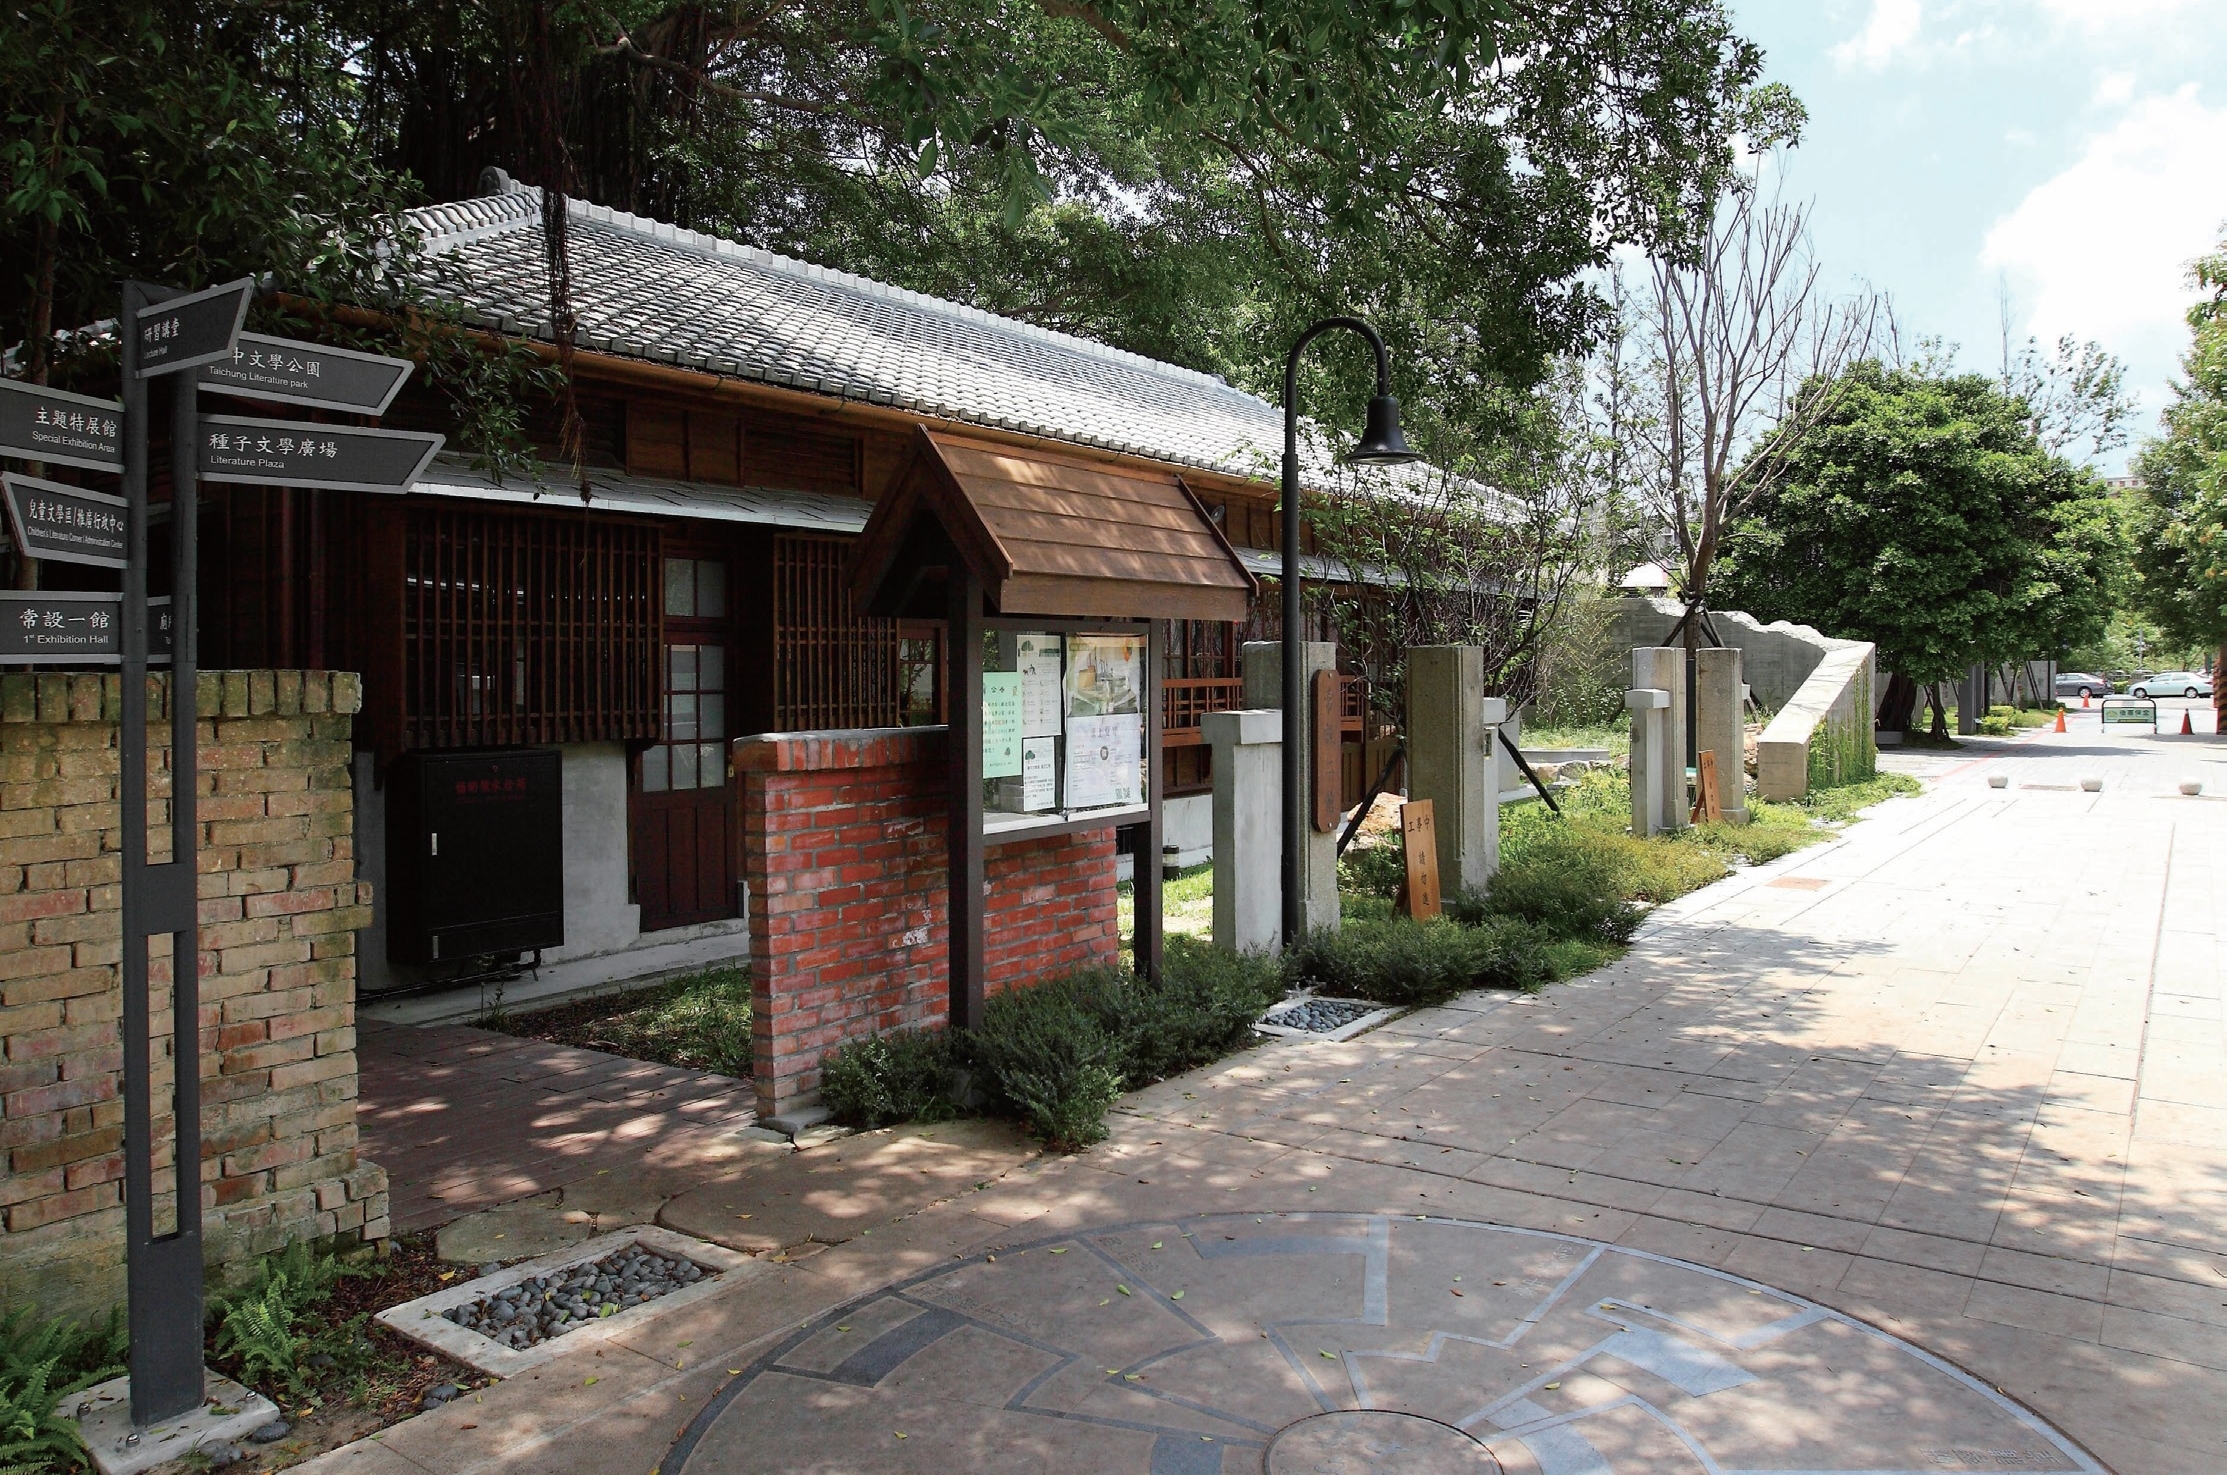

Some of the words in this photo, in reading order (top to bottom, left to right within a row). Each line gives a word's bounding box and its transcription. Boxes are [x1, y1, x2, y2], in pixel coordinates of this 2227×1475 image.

[144, 317, 180, 342] 研習講堂
[232, 346, 320, 378] 中文學公園
[209, 365, 247, 380] Taichung
[249, 371, 288, 386] Literature
[290, 380, 309, 389] park
[35, 405, 118, 438] 主題特展館
[32, 430, 61, 444] Special
[62, 436, 98, 450] Exhibition
[98, 442, 116, 453] Area
[209, 433, 338, 458] 種子文學廣場
[210, 455, 256, 466] Literature
[258, 458, 285, 469] Plaza
[19, 608, 110, 629] 常設一館
[24, 634, 35, 644] 1st
[37, 634, 87, 644] Exhibition
[89, 634, 109, 644] Hall
[1408, 814, 1431, 833] 工事中
